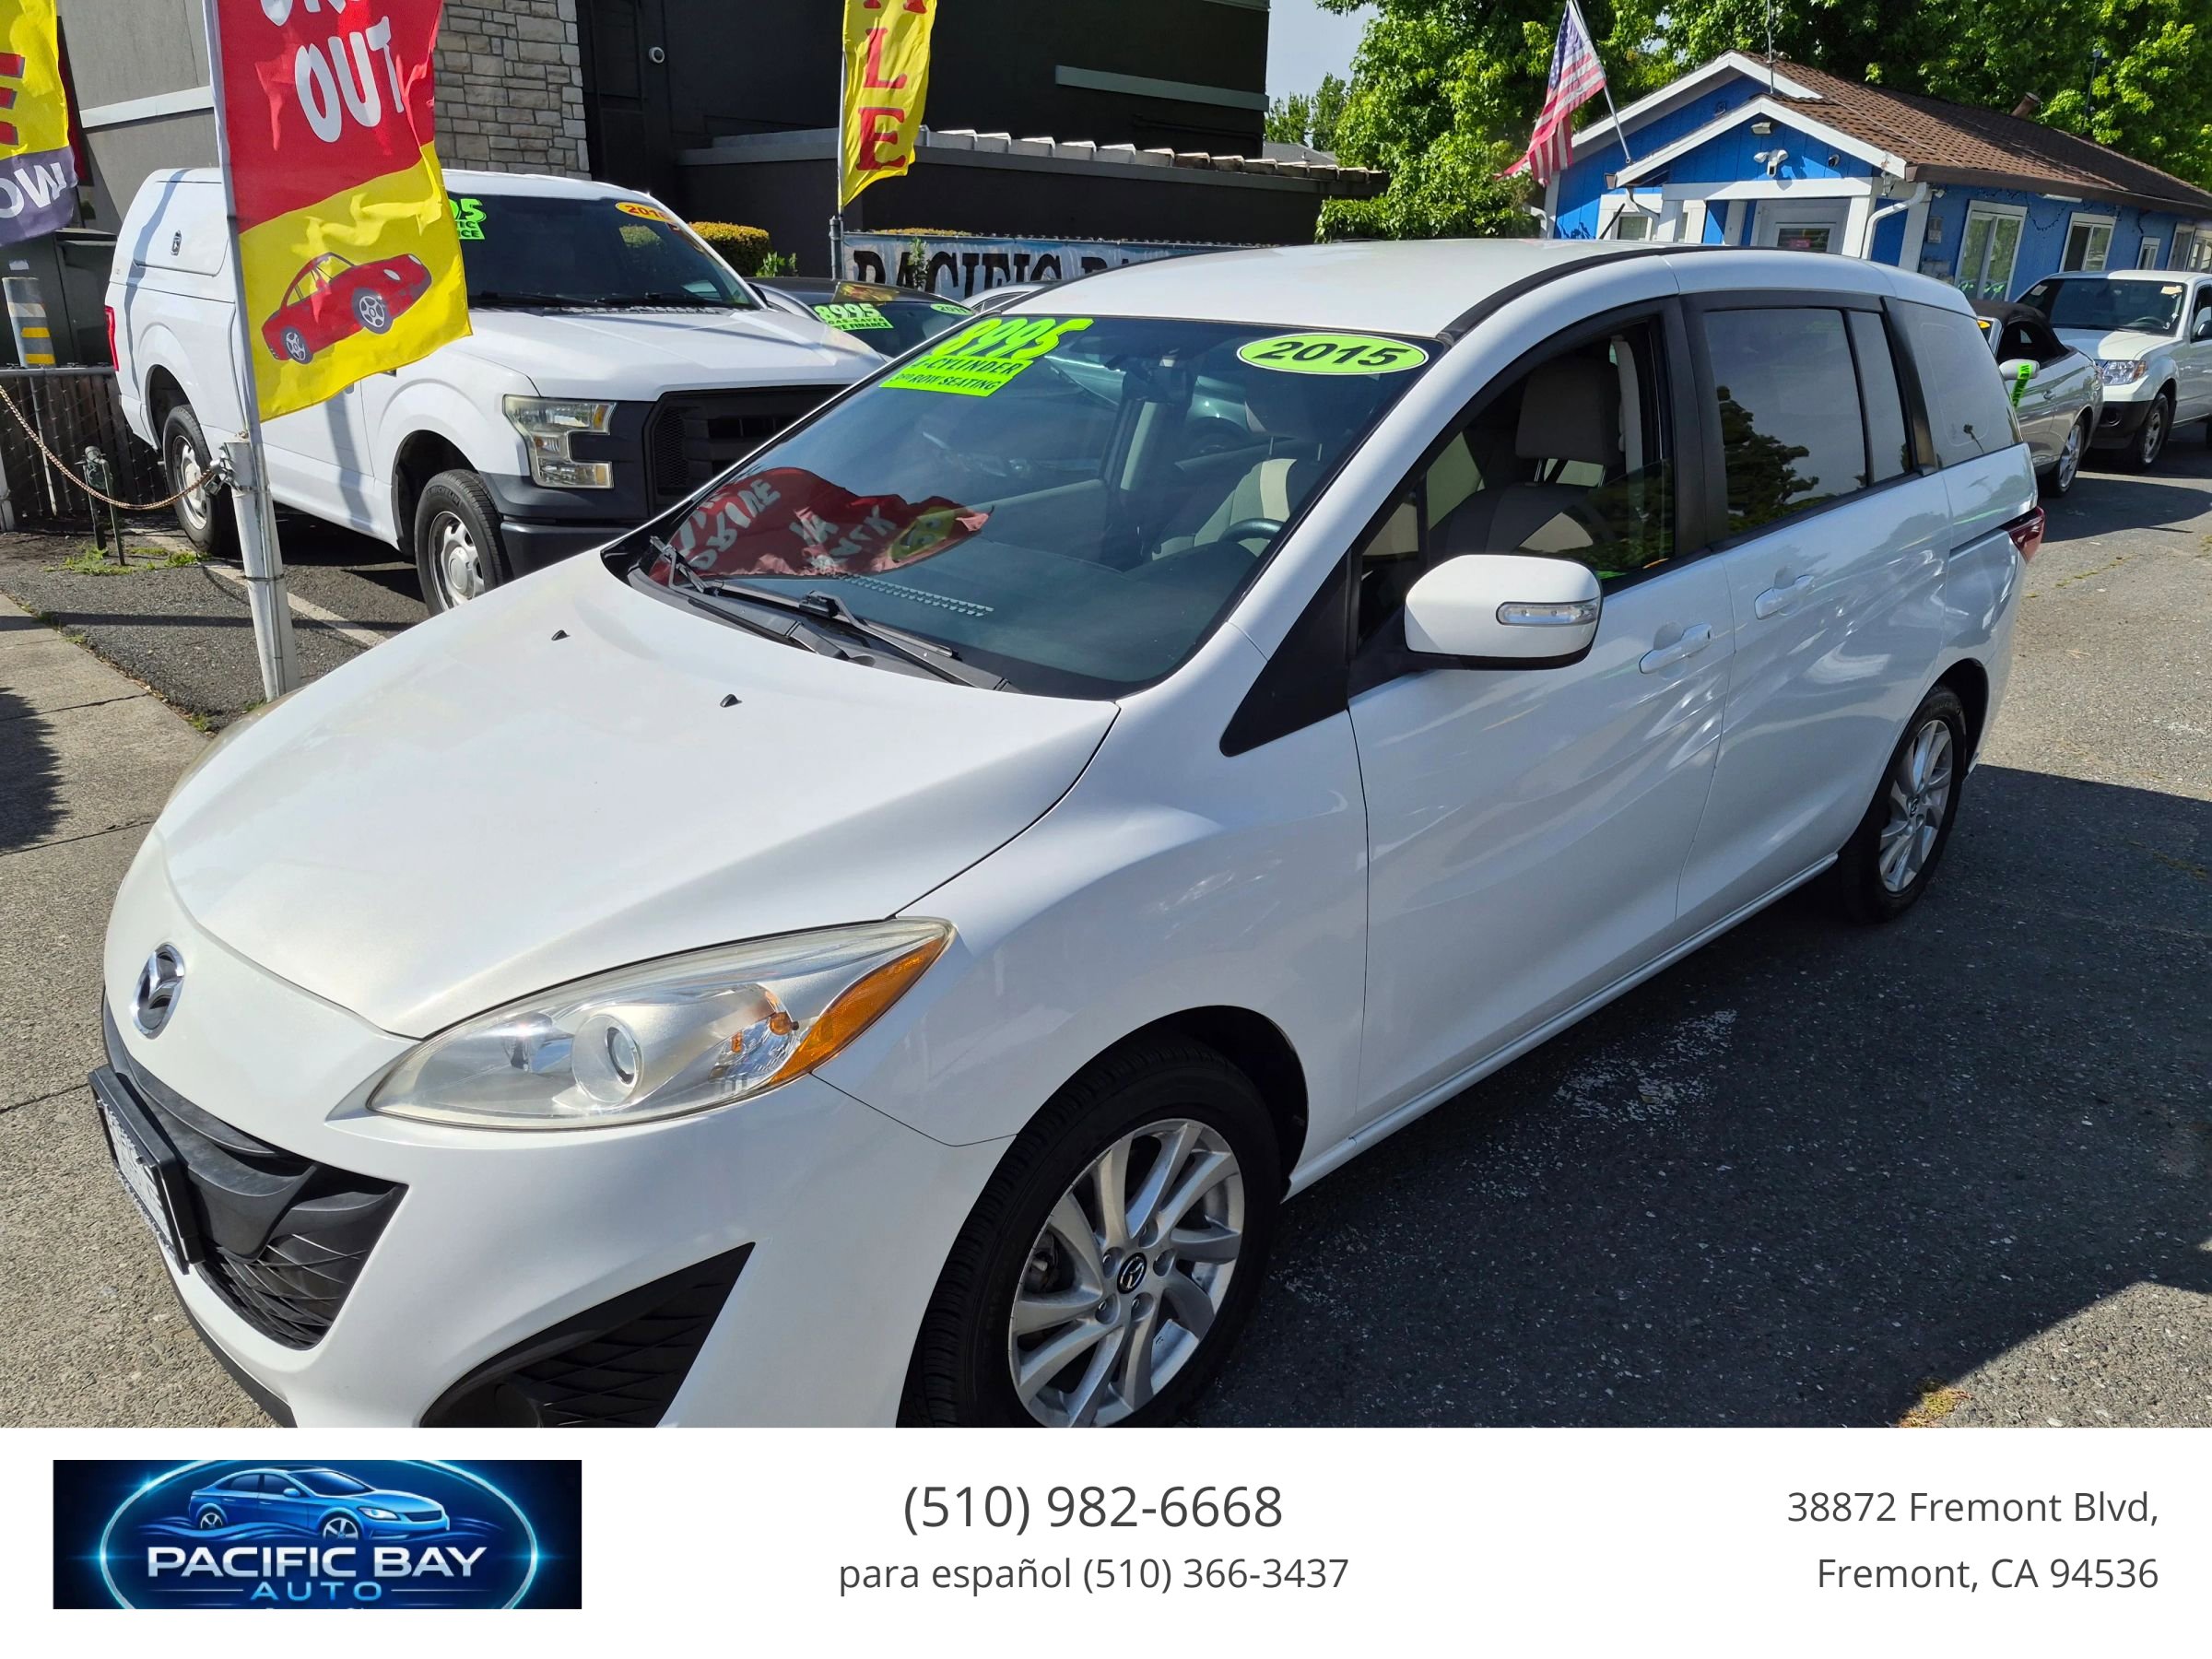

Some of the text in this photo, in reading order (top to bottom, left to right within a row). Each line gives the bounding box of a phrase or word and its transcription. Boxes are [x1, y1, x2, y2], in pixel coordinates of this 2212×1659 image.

[295, 16, 405, 143] OUT
[856, 0, 927, 171] LE
[814, 302, 882, 320] 8995
[932, 318, 1095, 361] 8995
[1253, 341, 1411, 366] 2015
[937, 376, 1002, 391] SEATING
